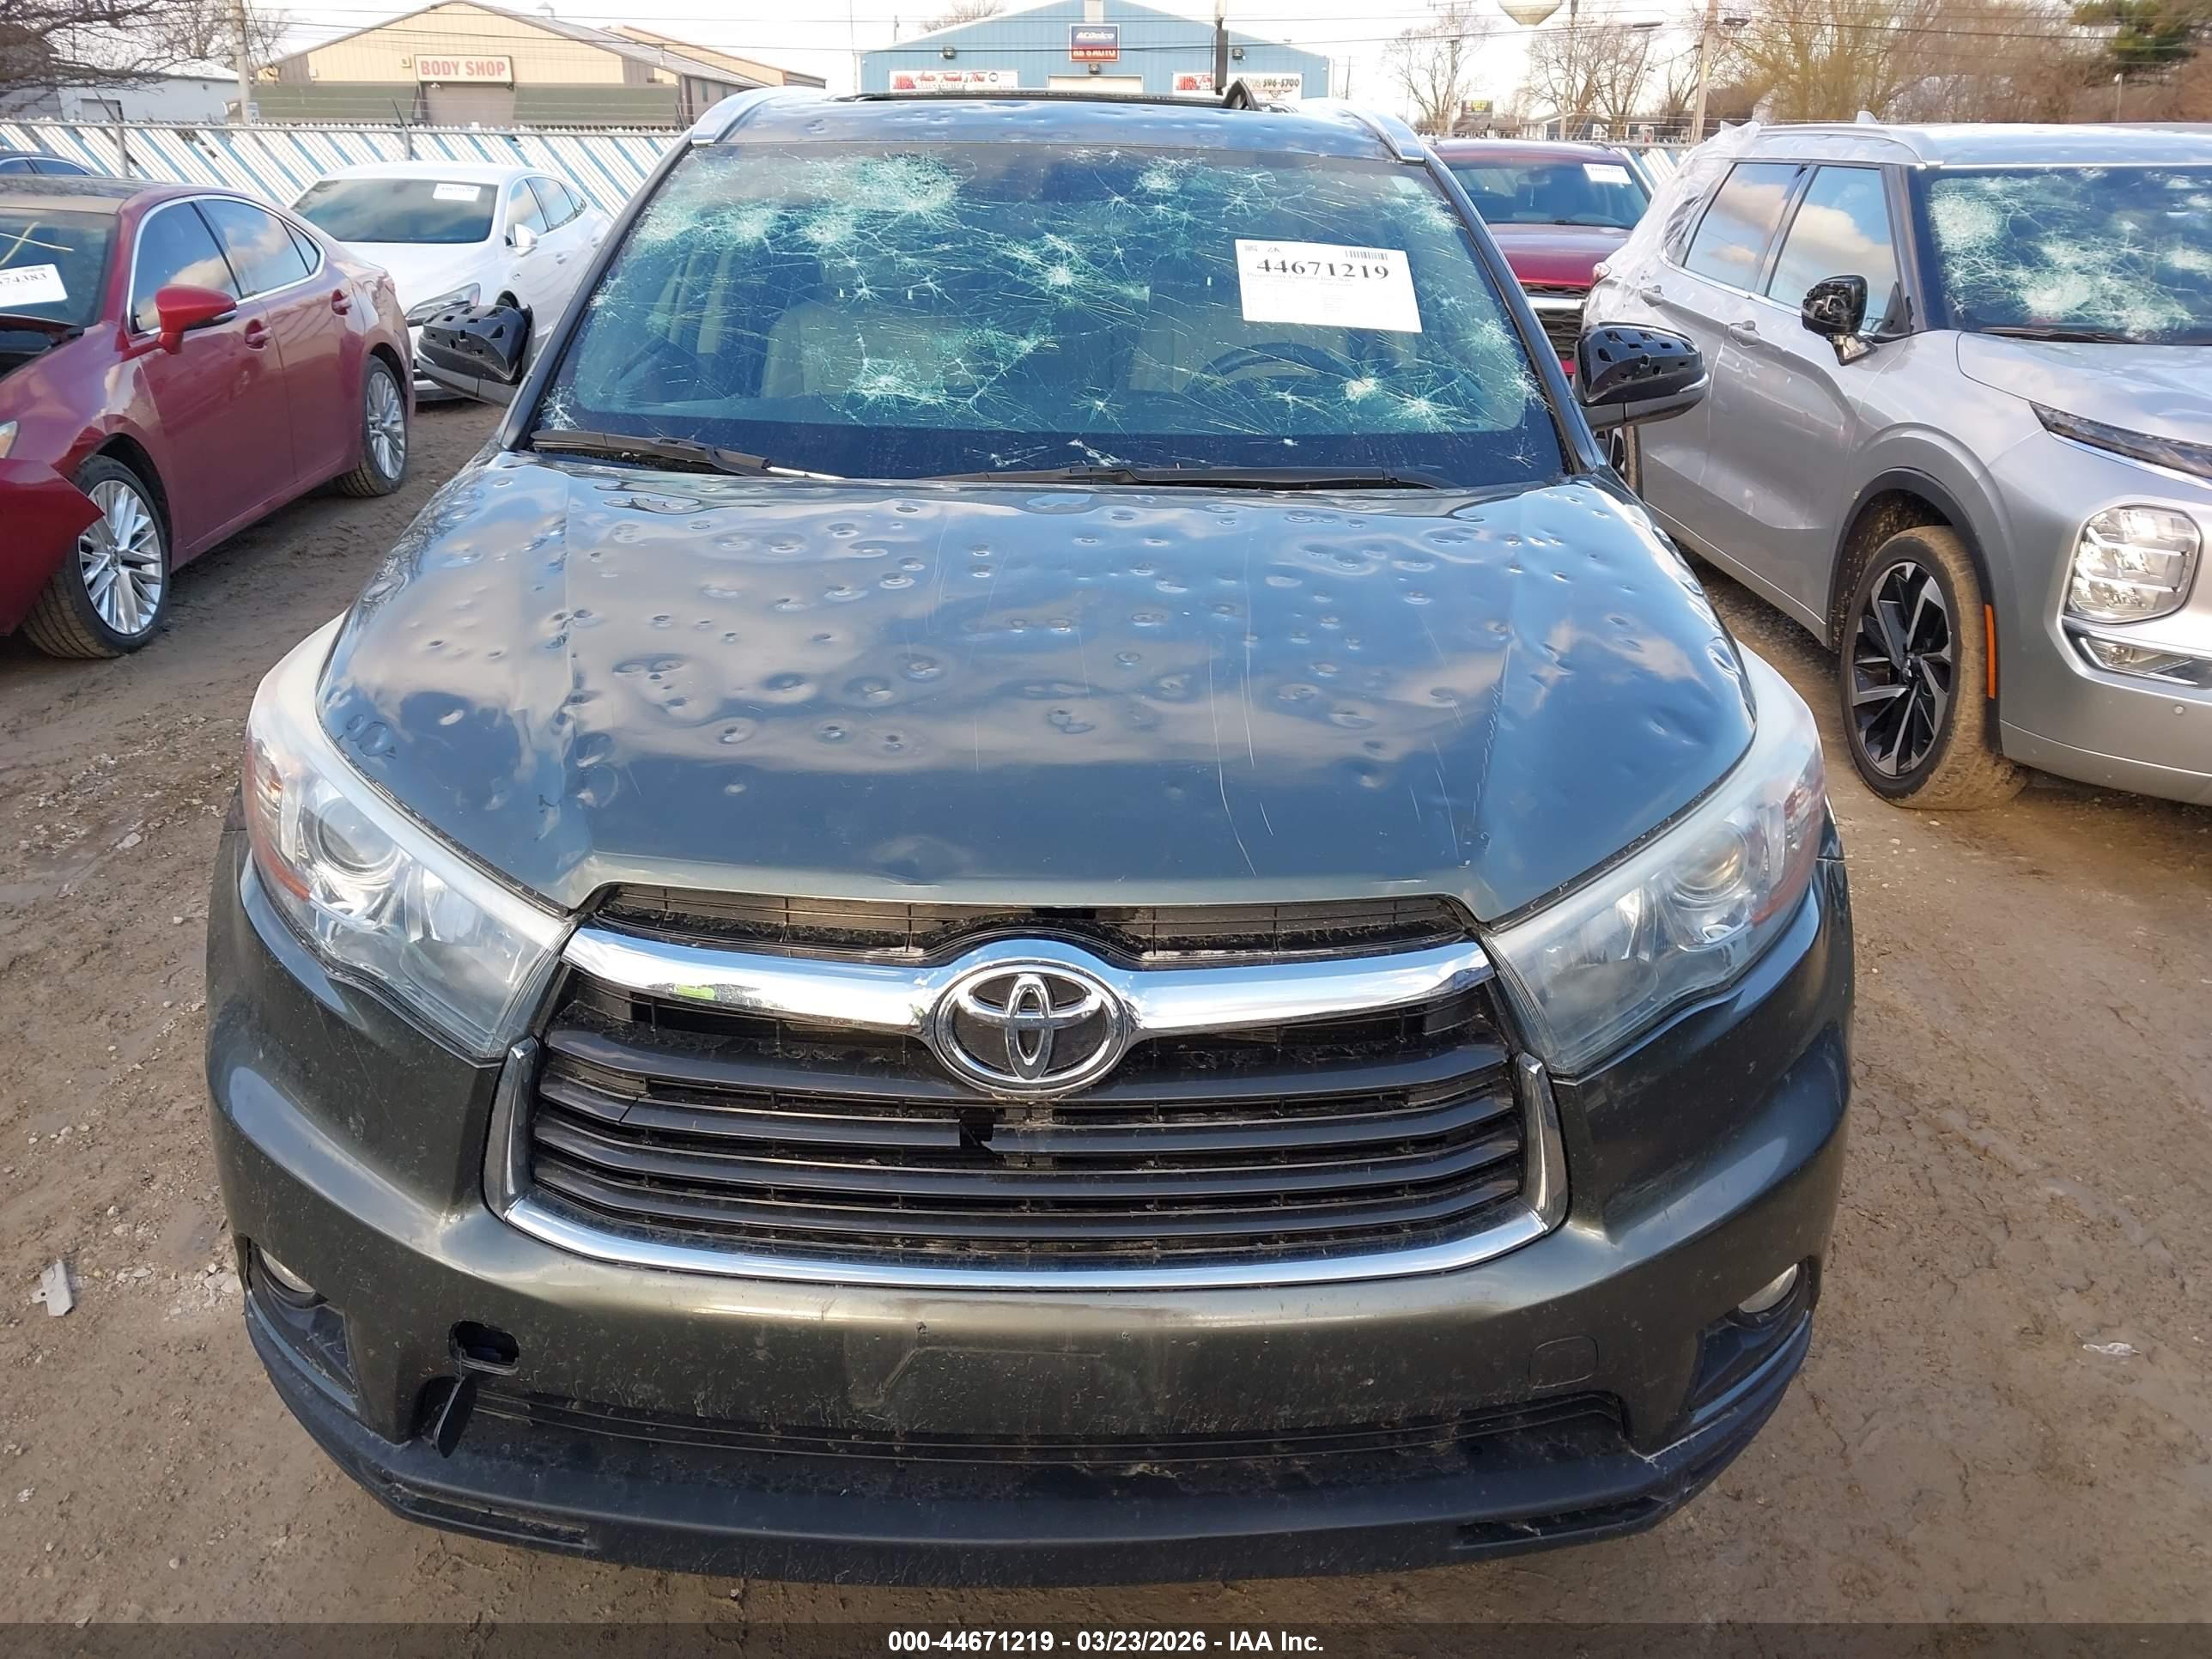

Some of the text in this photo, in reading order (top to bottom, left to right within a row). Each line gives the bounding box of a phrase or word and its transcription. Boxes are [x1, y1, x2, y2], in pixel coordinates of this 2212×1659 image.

[421, 60, 506, 76] BODY SHOP
[1256, 258, 1389, 280] 44671219
